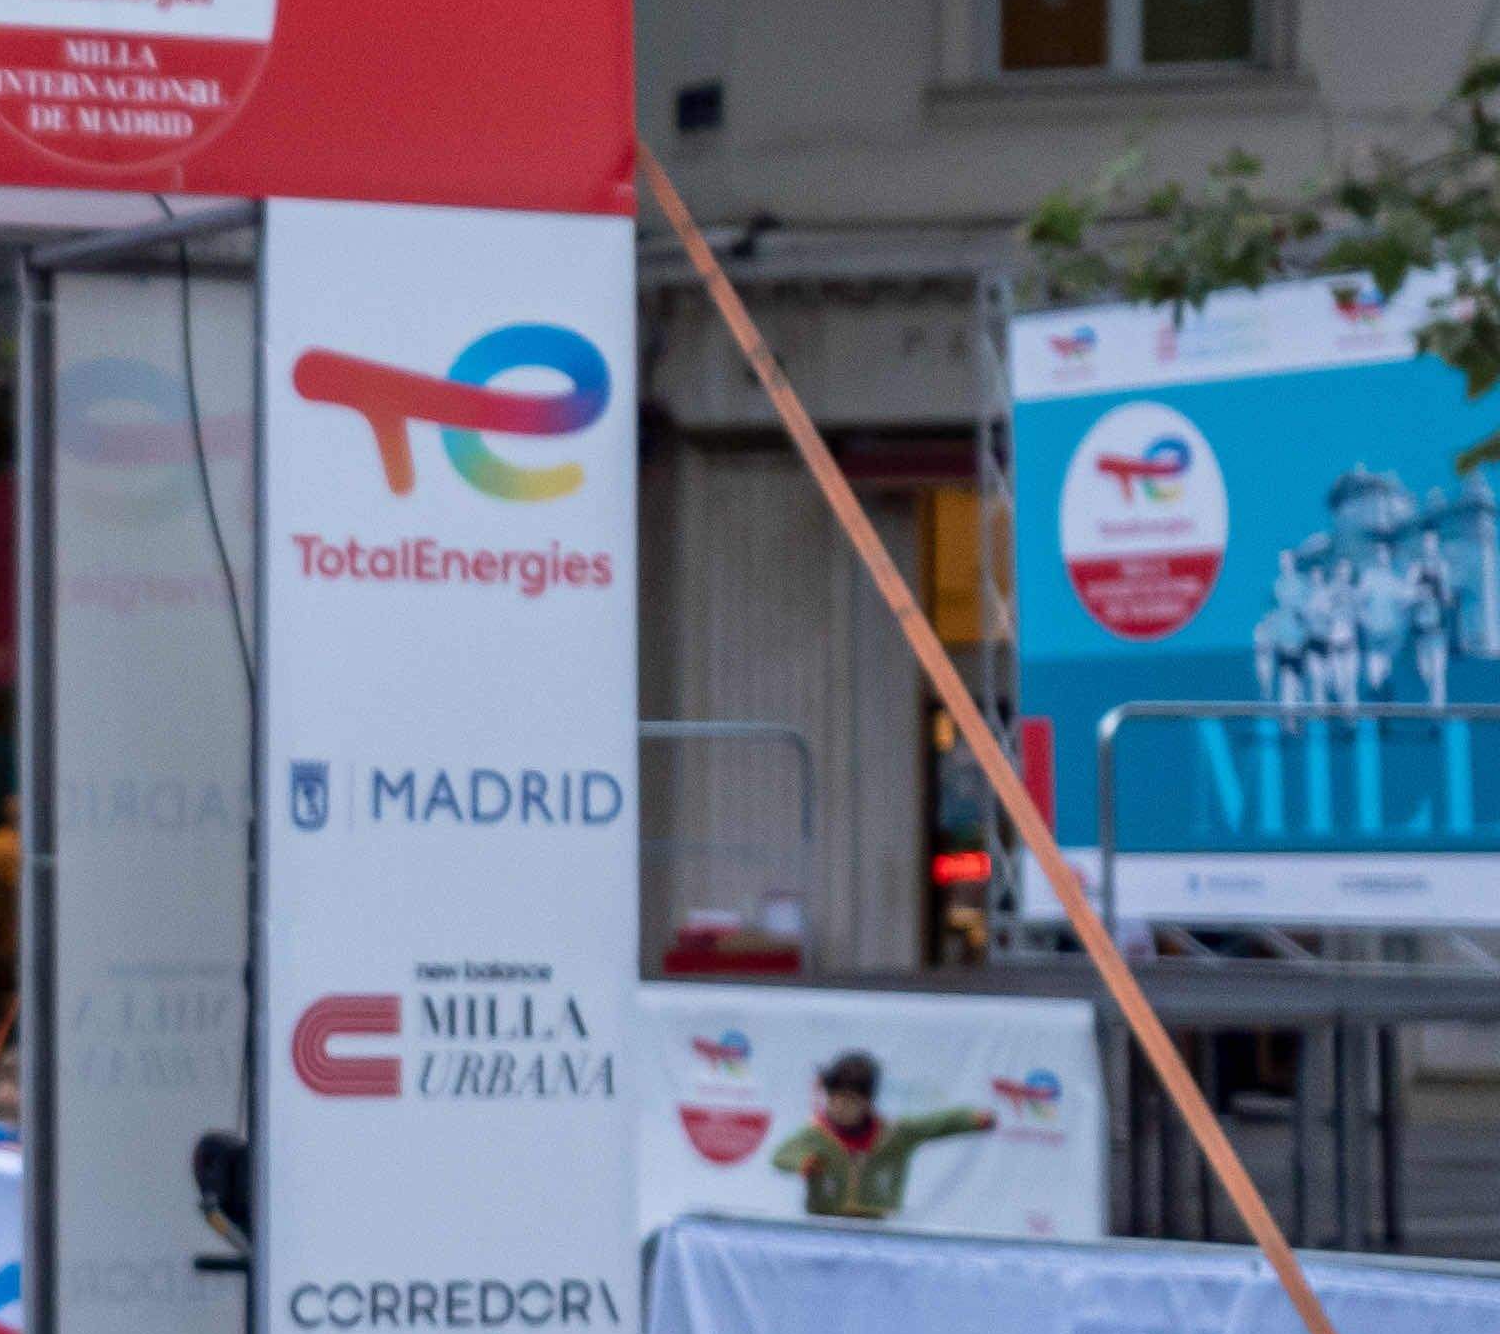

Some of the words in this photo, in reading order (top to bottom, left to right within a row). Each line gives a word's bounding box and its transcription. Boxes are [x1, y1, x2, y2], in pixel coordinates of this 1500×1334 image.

[64, 38, 156, 67] MILLA
[30, 107, 67, 131] DE
[79, 109, 194, 137] MADRID
[292, 533, 614, 598] TotalEnergies
[371, 767, 624, 825] MADRID
[416, 963, 458, 981] new
[464, 959, 552, 982] balance
[416, 994, 589, 1039] MILLA
[416, 1053, 618, 1098] URBANA
